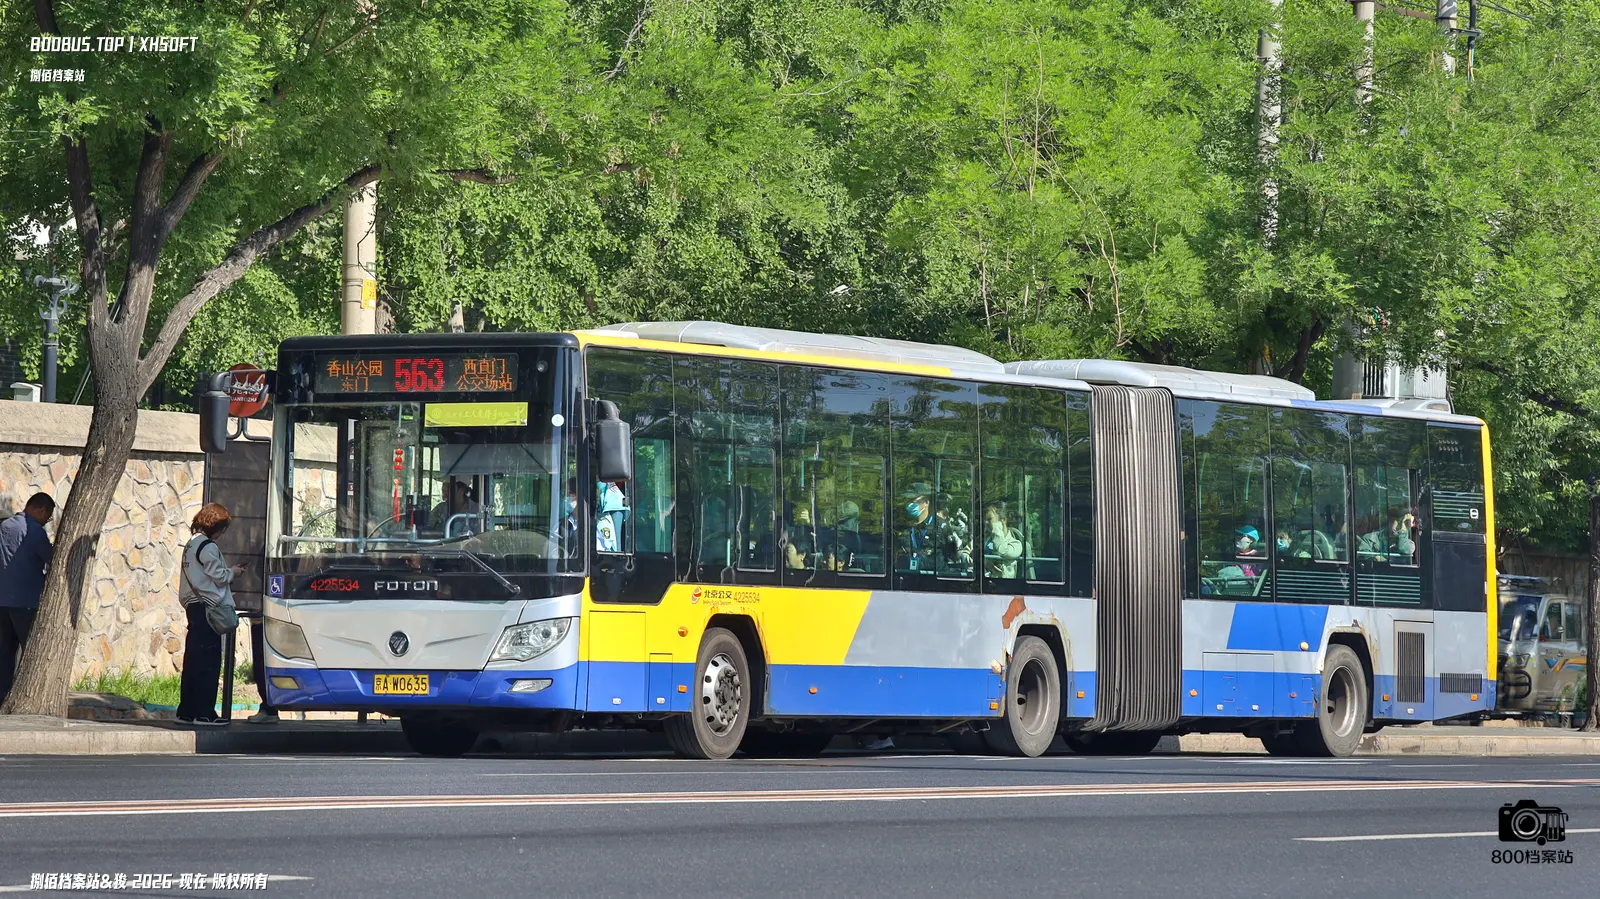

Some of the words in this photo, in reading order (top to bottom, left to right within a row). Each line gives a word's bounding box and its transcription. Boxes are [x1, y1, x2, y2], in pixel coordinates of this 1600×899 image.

[327, 359, 383, 377] 香山公园
[394, 358, 445, 391] 563
[463, 358, 506, 375] 西直门
[341, 376, 369, 392] 东门
[456, 374, 513, 391] 公交场站
[310, 579, 360, 591] 4225534
[374, 580, 439, 591] FOTON
[704, 590, 733, 599] 北京公交
[733, 592, 760, 603] 4225534
